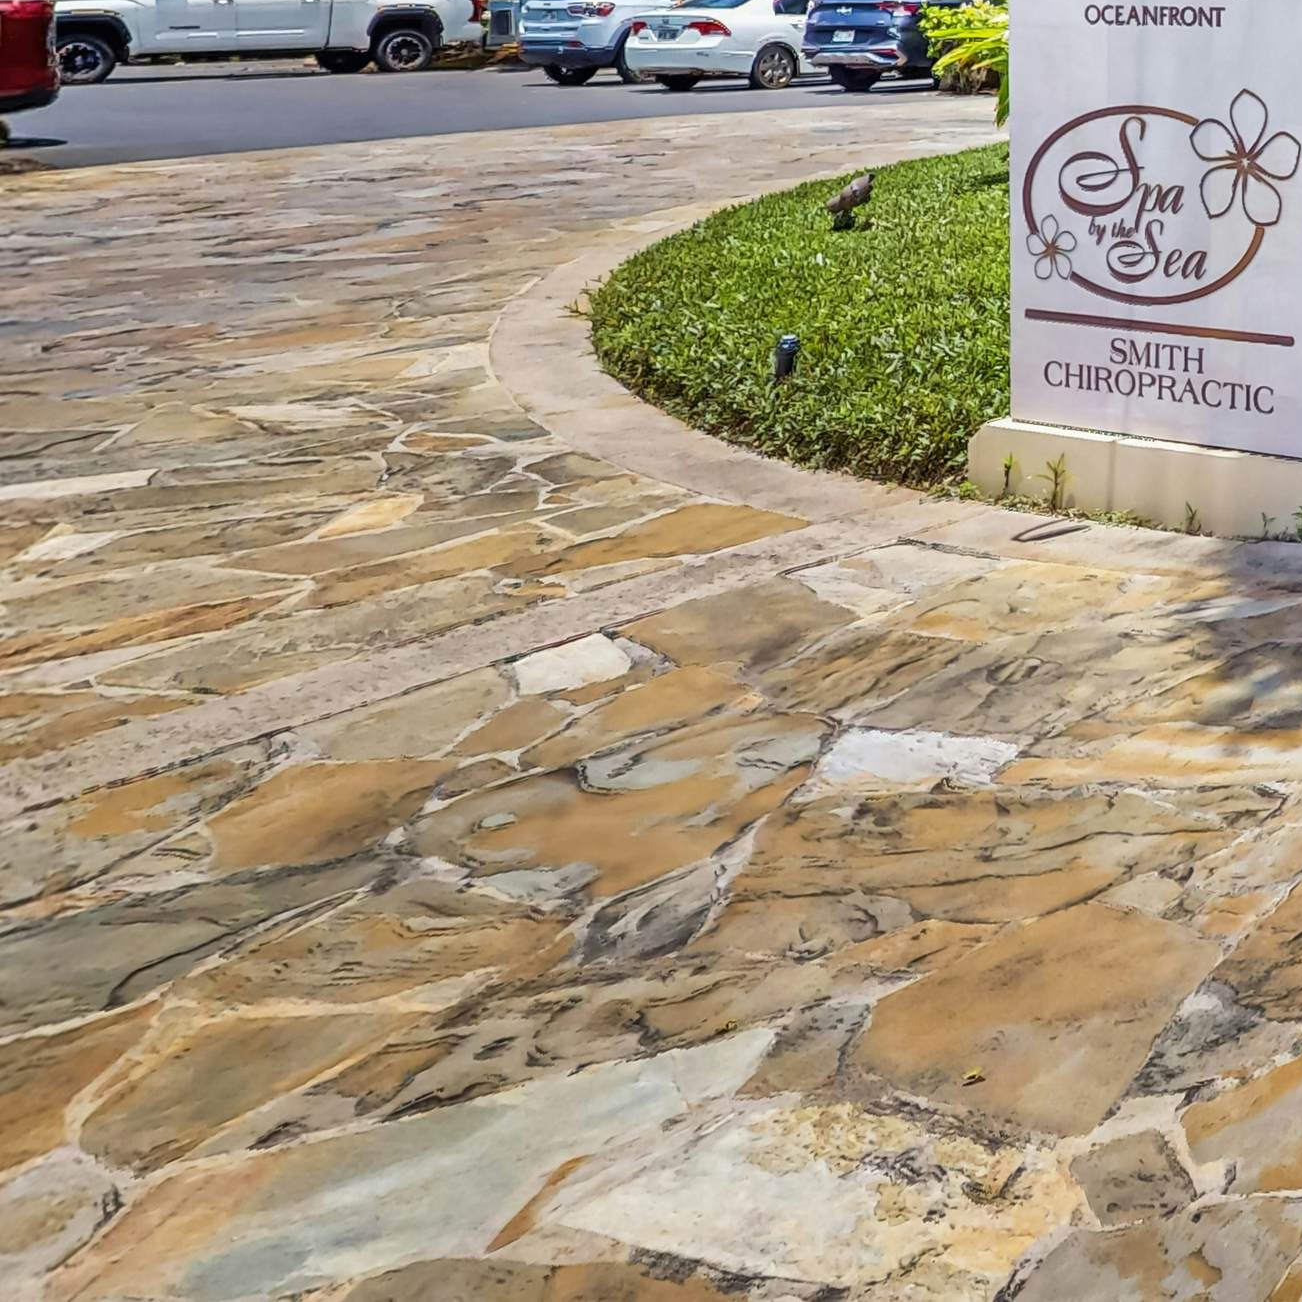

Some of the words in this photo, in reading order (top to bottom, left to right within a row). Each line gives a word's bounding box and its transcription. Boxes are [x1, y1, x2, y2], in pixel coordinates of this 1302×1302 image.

[1084, 4, 1226, 28] OCEANFRONT
[1058, 116, 1185, 233] Spa
[1088, 216, 1106, 245] by
[1111, 218, 1136, 239] the
[1106, 219, 1208, 284] Sea
[1109, 337, 1205, 375] SMITH
[1043, 360, 1275, 416] CHIROPRACTIC
